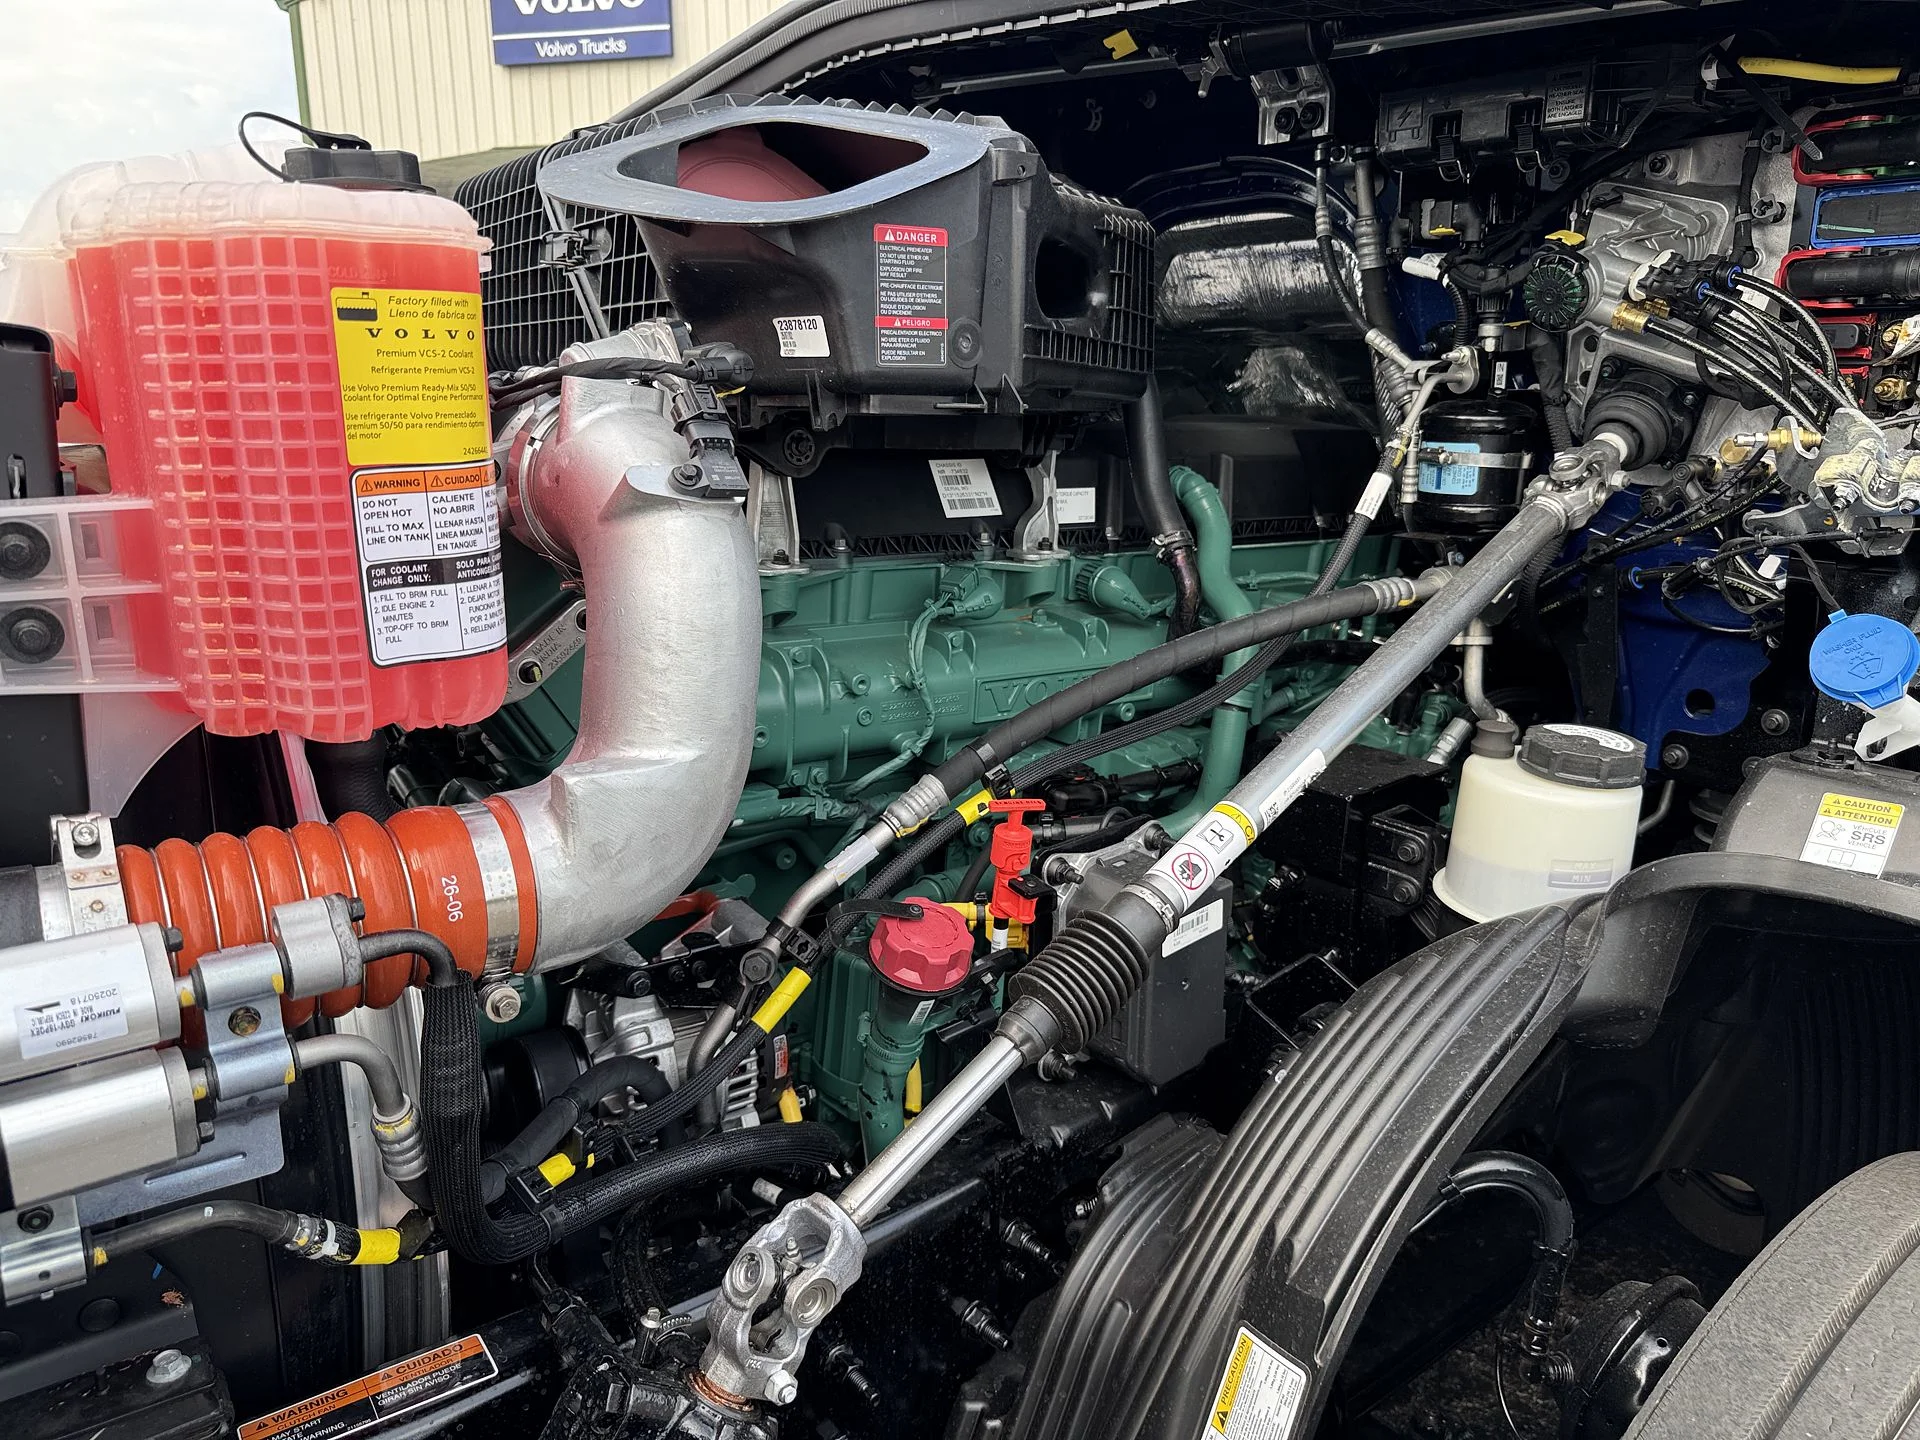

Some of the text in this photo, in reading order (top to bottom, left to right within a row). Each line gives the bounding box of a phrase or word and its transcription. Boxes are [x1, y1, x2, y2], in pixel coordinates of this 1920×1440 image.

[535, 36, 627, 58] Volvo Trucks
[896, 231, 937, 243] DANGER
[388, 296, 469, 308] Factory filled with
[389, 309, 418, 318] Lleno
[422, 309, 434, 319] de
[437, 310, 464, 320] fabrica
[777, 318, 818, 330] 23878120
[902, 319, 931, 327] PELIGRO
[365, 327, 475, 341] VOLVO
[376, 349, 473, 359] Premium VCS-2 Coolant
[371, 366, 475, 376] Refrigerante Premium VCS-2
[343, 384, 477, 393] Use Volvo Premium Ready-Mix 50/50
[343, 393, 371, 402] Coolant
[372, 393, 385, 402] for
[386, 393, 420, 403] Optimal
[421, 393, 448, 403] Engine
[345, 411, 477, 421] Use refrigerante Volvo Premezclado
[346, 420, 467, 431] premium 50/50 para rendimiento
[347, 432, 382, 440] del motor
[374, 479, 421, 489] WARNING
[444, 474, 480, 485] CUIDADO
[362, 498, 398, 510] DO NOT
[432, 493, 475, 504] CALIENTE
[363, 508, 412, 521] OPEN HOT
[433, 504, 475, 515] NO ABRIR
[365, 521, 424, 535] FILL TO MAX
[434, 519, 464, 529] LLENAR
[465, 516, 484, 525] HASTA
[366, 532, 430, 546] LINE ON TANK
[436, 531, 458, 540] LINEA
[459, 528, 484, 538] MAXIMA
[437, 540, 478, 551] EN TANQUE
[456, 560, 474, 569] SOLO
[476, 557, 492, 566] PARA
[371, 564, 428, 578] FOR COOLANT
[373, 574, 431, 588] CHANGE ONLY:
[466, 583, 488, 593] LLENAR
[373, 589, 448, 604] 1. FILL TO BRIM FULL
[467, 594, 486, 603] DEJAR
[374, 600, 435, 614] 2. IDLE ENGINE 2
[382, 612, 414, 623] MINUTES
[470, 616, 483, 624] POR
[377, 620, 449, 636] 3. TOP-OFF TO BRIM
[470, 622, 496, 634] RELLENAR
[385, 635, 402, 644] FULL
[531, 624, 568, 656] MADE IN
[1822, 626, 1882, 655] WASHER FLUID
[538, 641, 562, 664] INDIA
[1843, 643, 1863, 655] ONLY
[1844, 800, 1892, 813] CAUTION
[1834, 810, 1893, 825] ATTENTION
[1851, 830, 1886, 845] SRS
[1847, 840, 1877, 850] VEHICLE
[1572, 874, 1591, 883] MIN
[441, 875, 463, 922] 26-06
[70, 988, 118, 1005] 20250718
[80, 1007, 121, 1023] FUJIKOKI
[395, 1343, 463, 1374] CUIDADO
[399, 1358, 454, 1383] VENTILADOR
[1221, 1337, 1247, 1405] PRECAUTION
[375, 1362, 462, 1401] VENTILADOR PUEDE
[378, 1373, 451, 1406] GIRAR SIN AVISO.
[271, 1388, 350, 1423] WARNING
[277, 1403, 337, 1431] CLUTCH FAN
[298, 1418, 322, 1432] START
